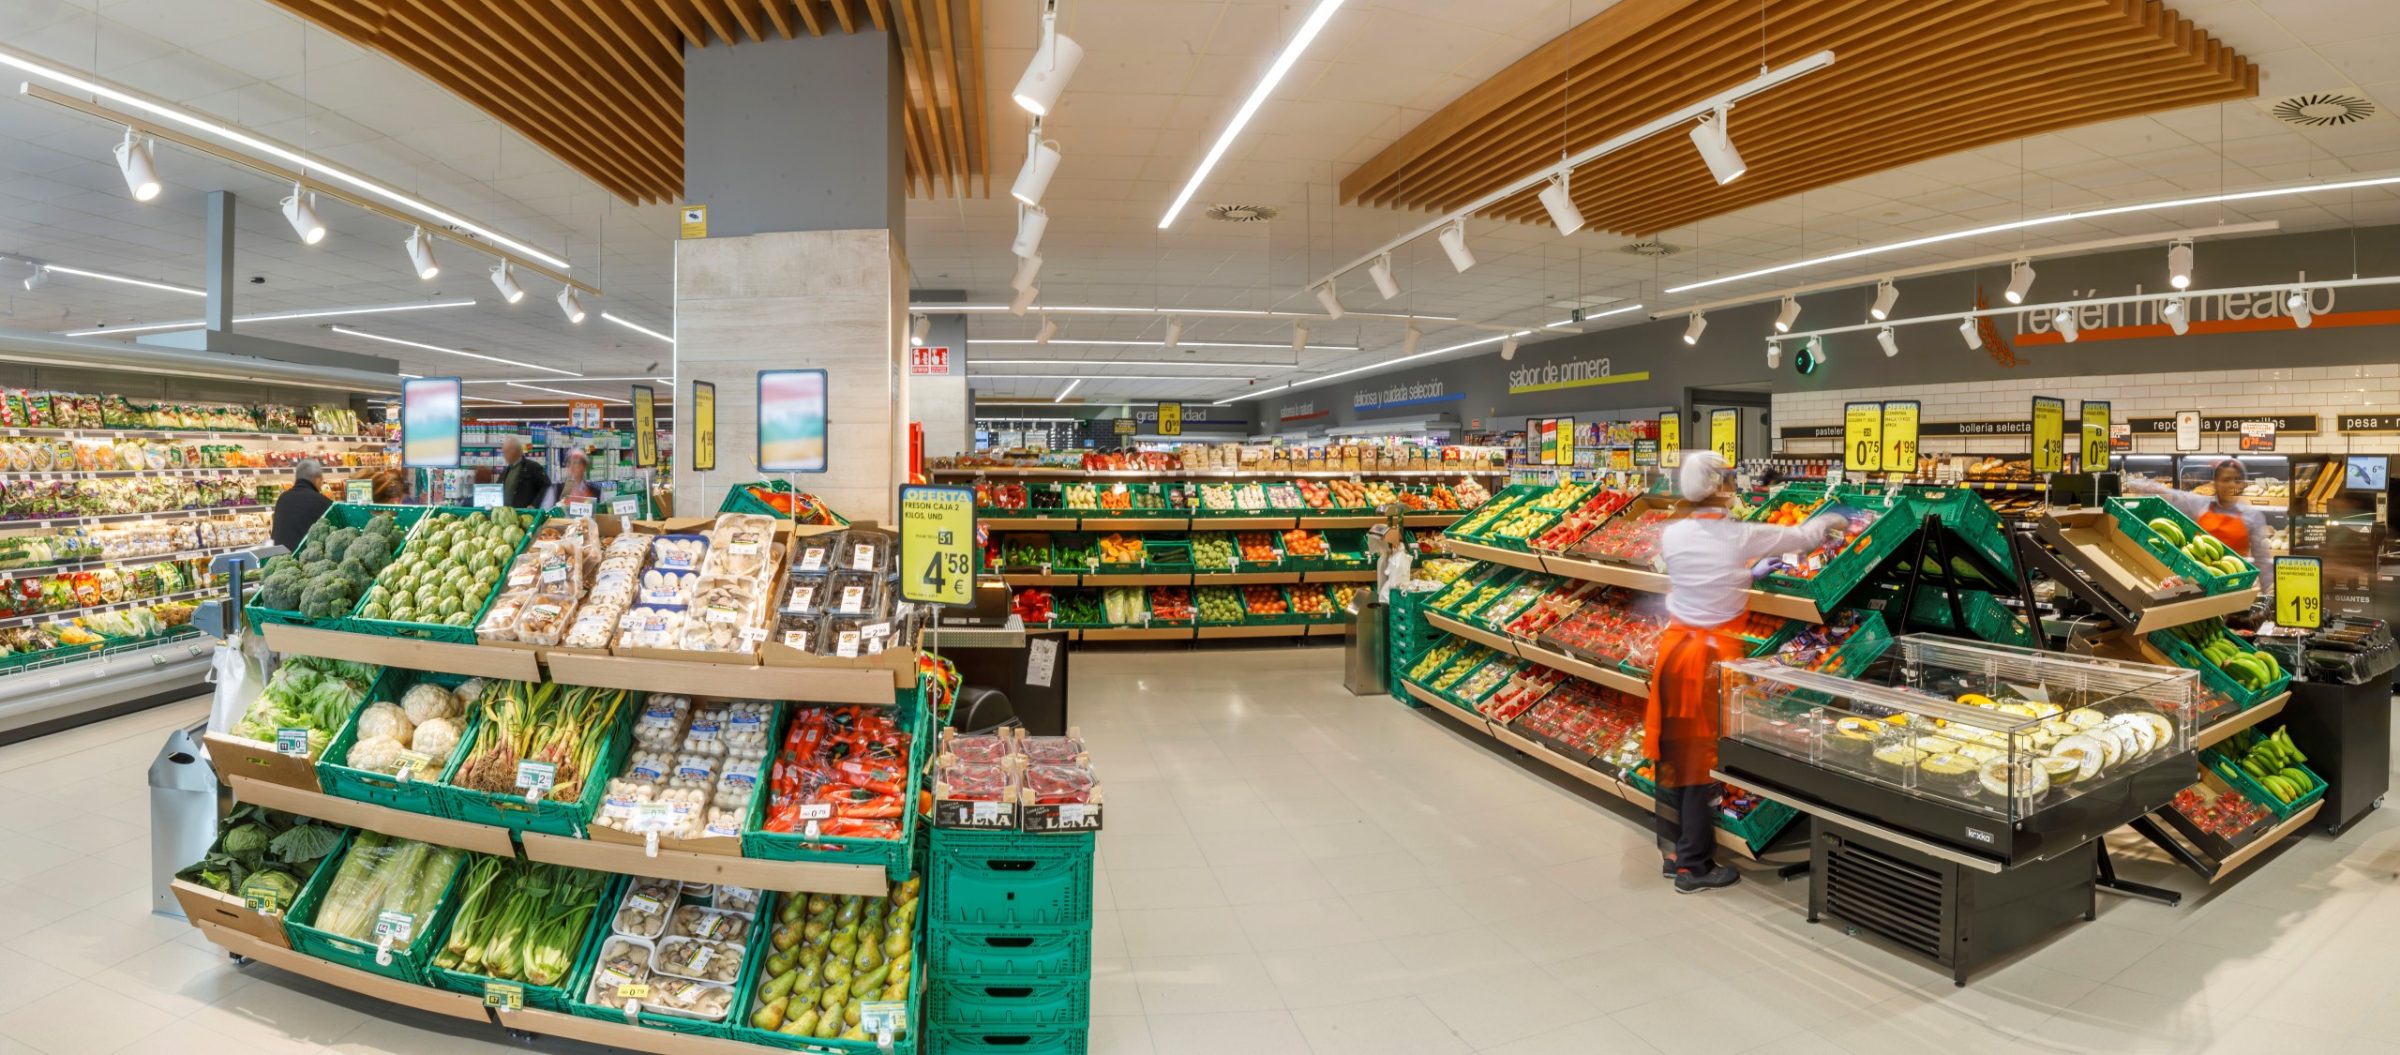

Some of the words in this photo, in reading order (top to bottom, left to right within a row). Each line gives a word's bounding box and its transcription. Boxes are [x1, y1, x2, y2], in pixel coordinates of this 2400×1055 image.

[1509, 364, 1541, 388] sabor
[1542, 360, 1559, 383] de
[1561, 356, 1610, 389] primera
[1383, 383, 1408, 404] cuidada
[1409, 376, 1443, 401] selección
[1136, 409, 1158, 424] gra
[1996, 422, 2032, 433] selecta
[2153, 418, 2211, 432] repoía
[2214, 419, 2222, 431] y
[2347, 418, 2378, 431] pesa
[1815, 427, 1844, 437] pasteler
[906, 488, 968, 503] OFERTA
[905, 501, 931, 510] FRESON
[933, 502, 953, 511] CAJA
[939, 532, 952, 545] 51
[954, 579, 964, 595] €
[2335, 594, 2370, 604] GUANTES
